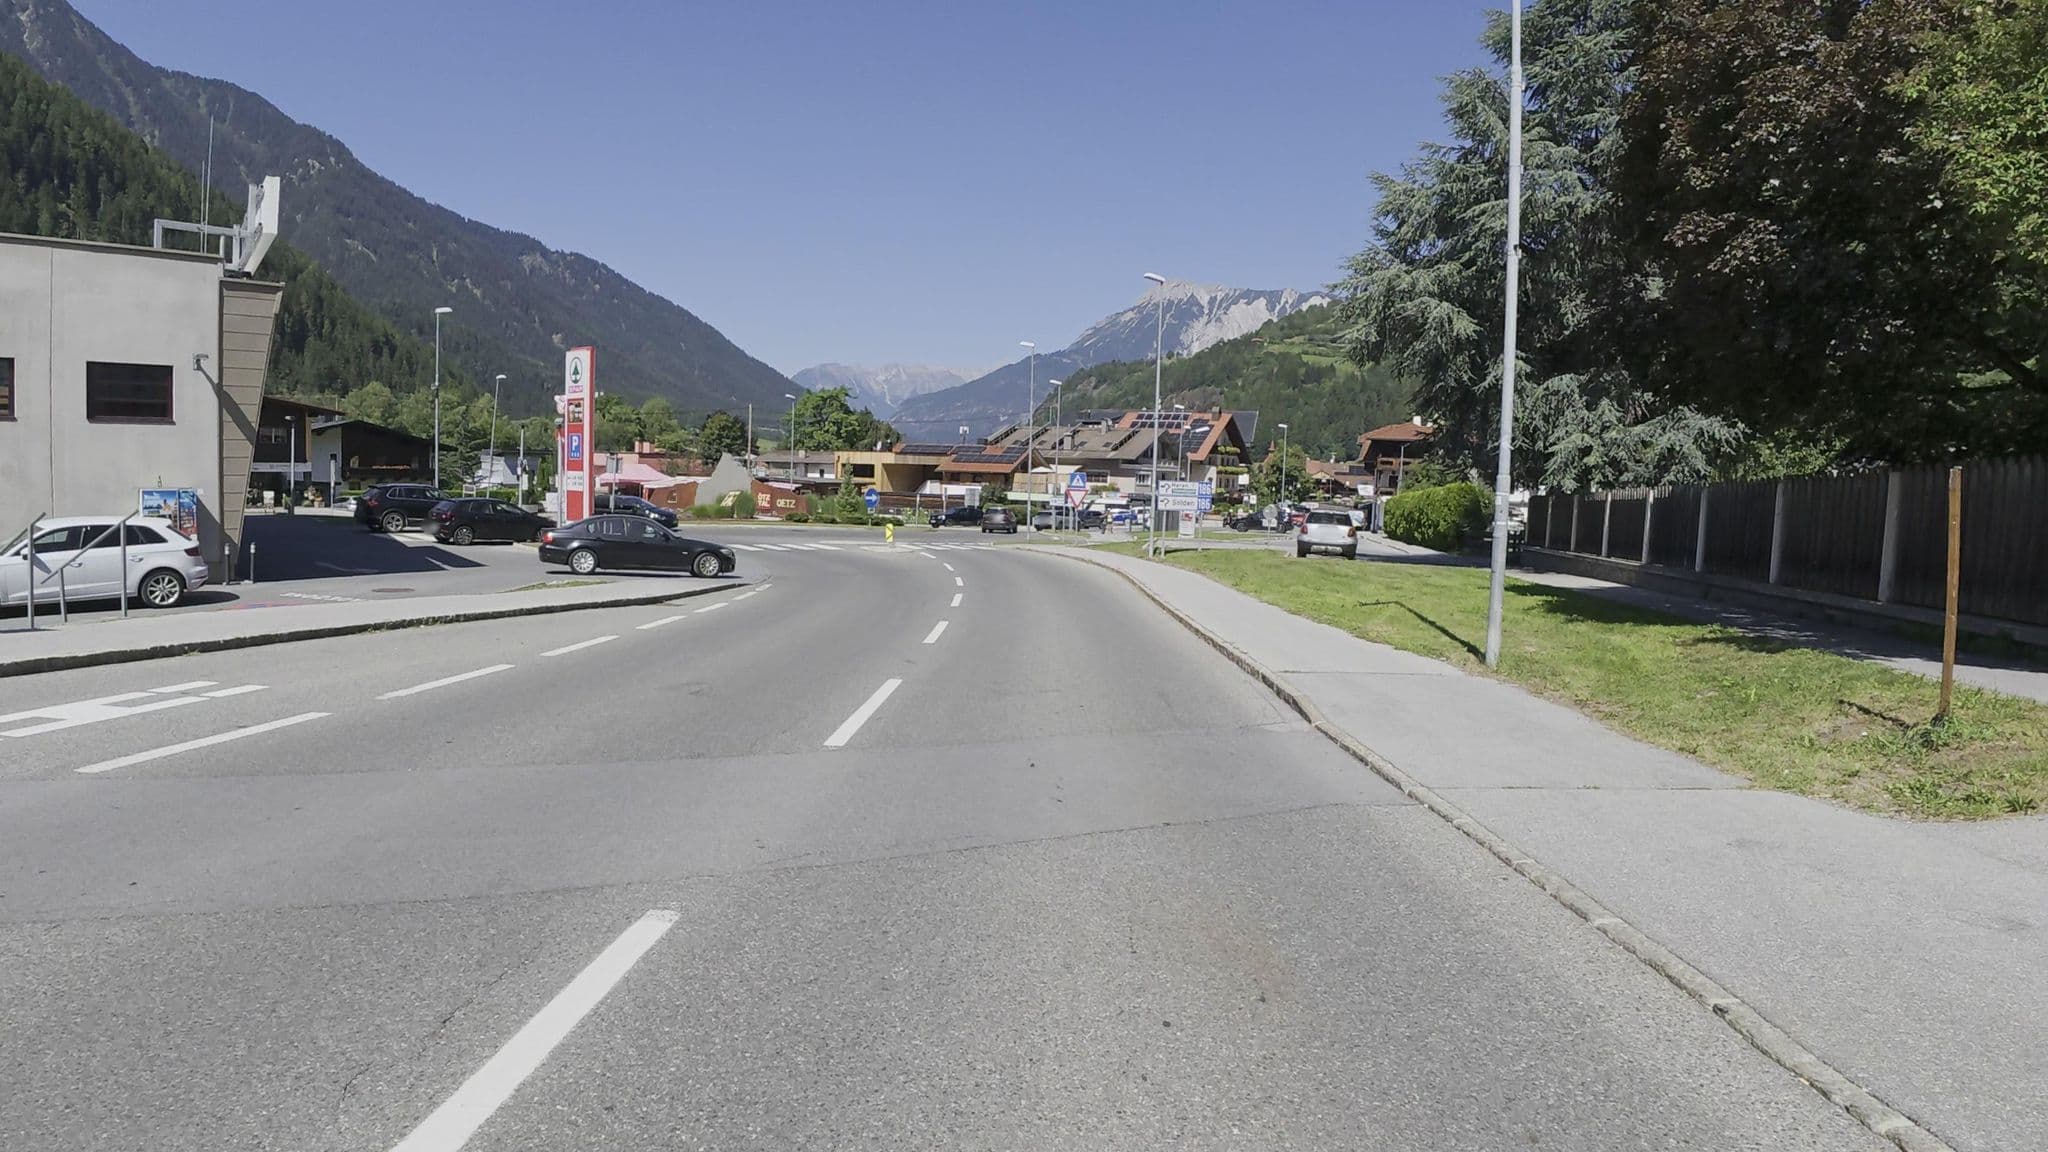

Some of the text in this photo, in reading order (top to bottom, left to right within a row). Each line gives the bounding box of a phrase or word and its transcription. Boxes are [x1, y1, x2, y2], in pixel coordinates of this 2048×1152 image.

[572, 435, 579, 451] P
[1199, 483, 1211, 495] 186
[776, 499, 796, 508] OETZ
[1198, 498, 1210, 510] 186
